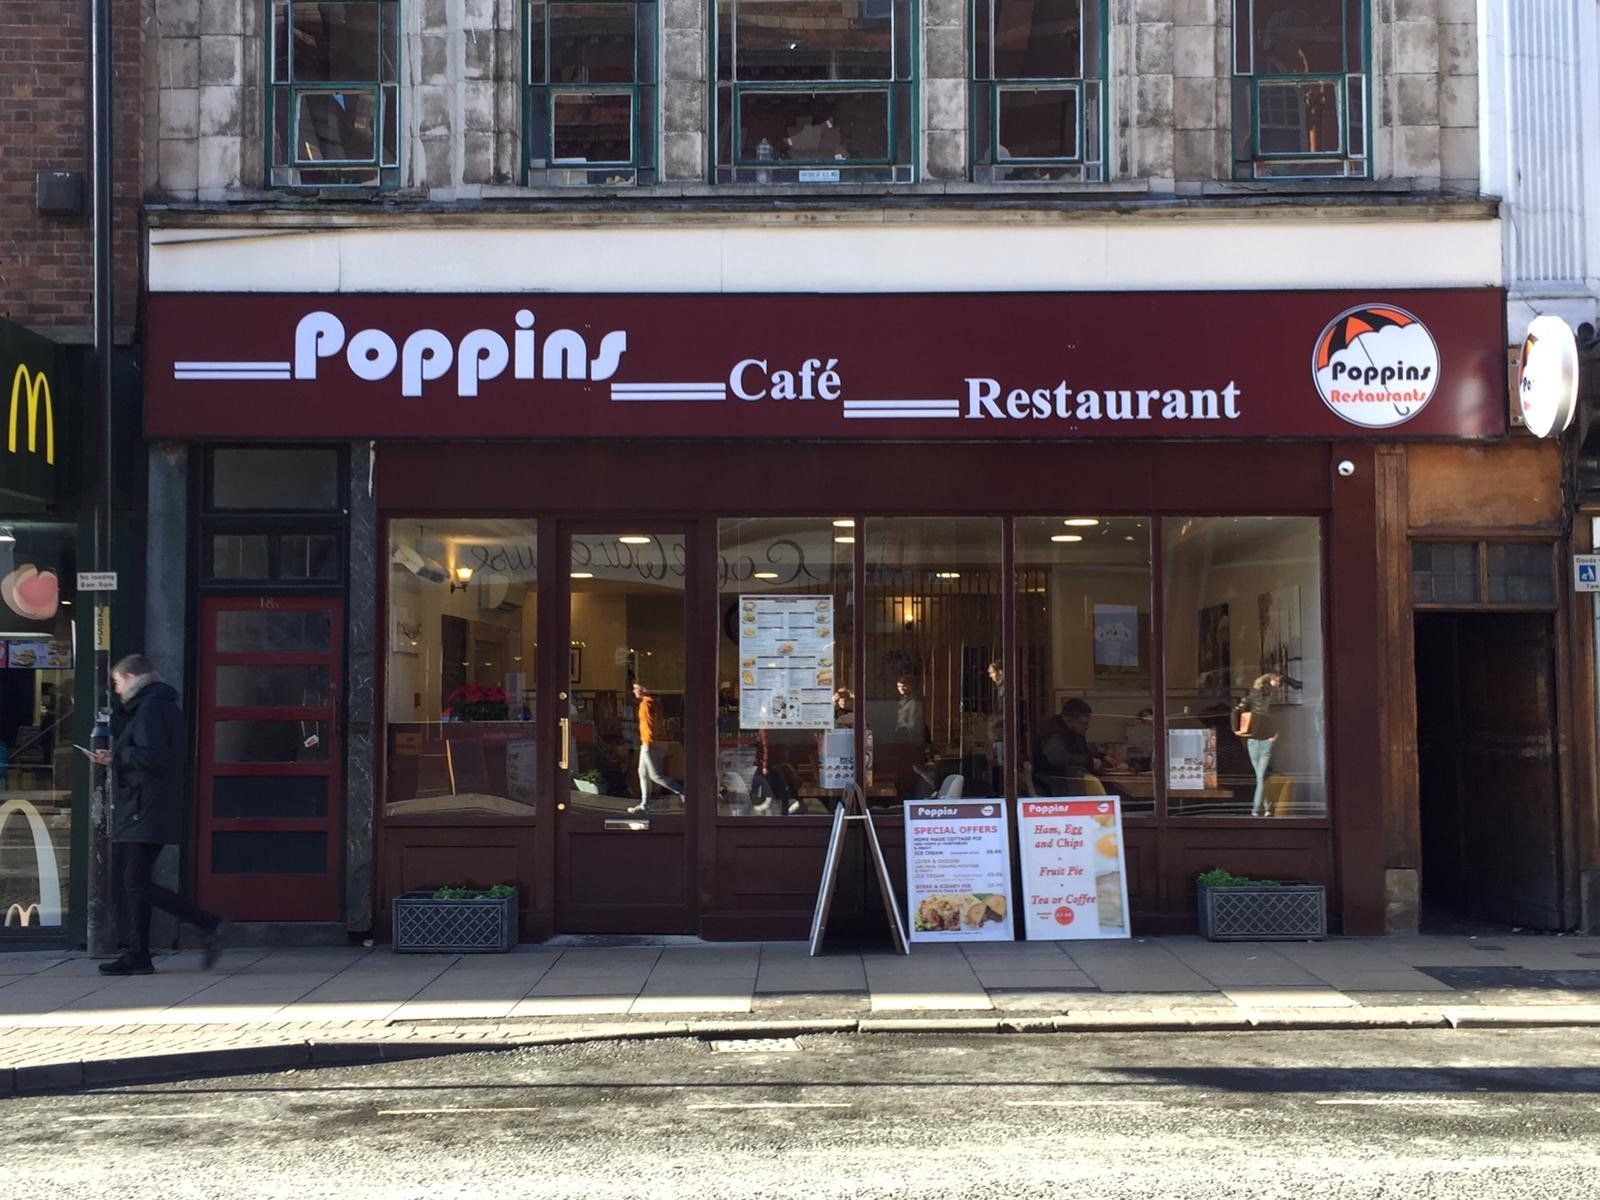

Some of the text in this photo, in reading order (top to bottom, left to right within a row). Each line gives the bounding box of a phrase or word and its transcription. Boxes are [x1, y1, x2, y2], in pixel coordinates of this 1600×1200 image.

[294, 309, 1241, 420] Poppins Café Restaurant
[1331, 360, 1431, 386] Poppins
[1330, 388, 1427, 403] Restaurants
[918, 806, 958, 817] Poppins
[1028, 804, 1069, 814] Poppins
[914, 825, 998, 835] SPECIAL OFFERS
[1034, 824, 1083, 836] Ham, Egg
[1035, 838, 1083, 850] and Chips
[1039, 865, 1084, 876] Fruit Pie
[1032, 894, 1097, 906] Tea or Coffee
